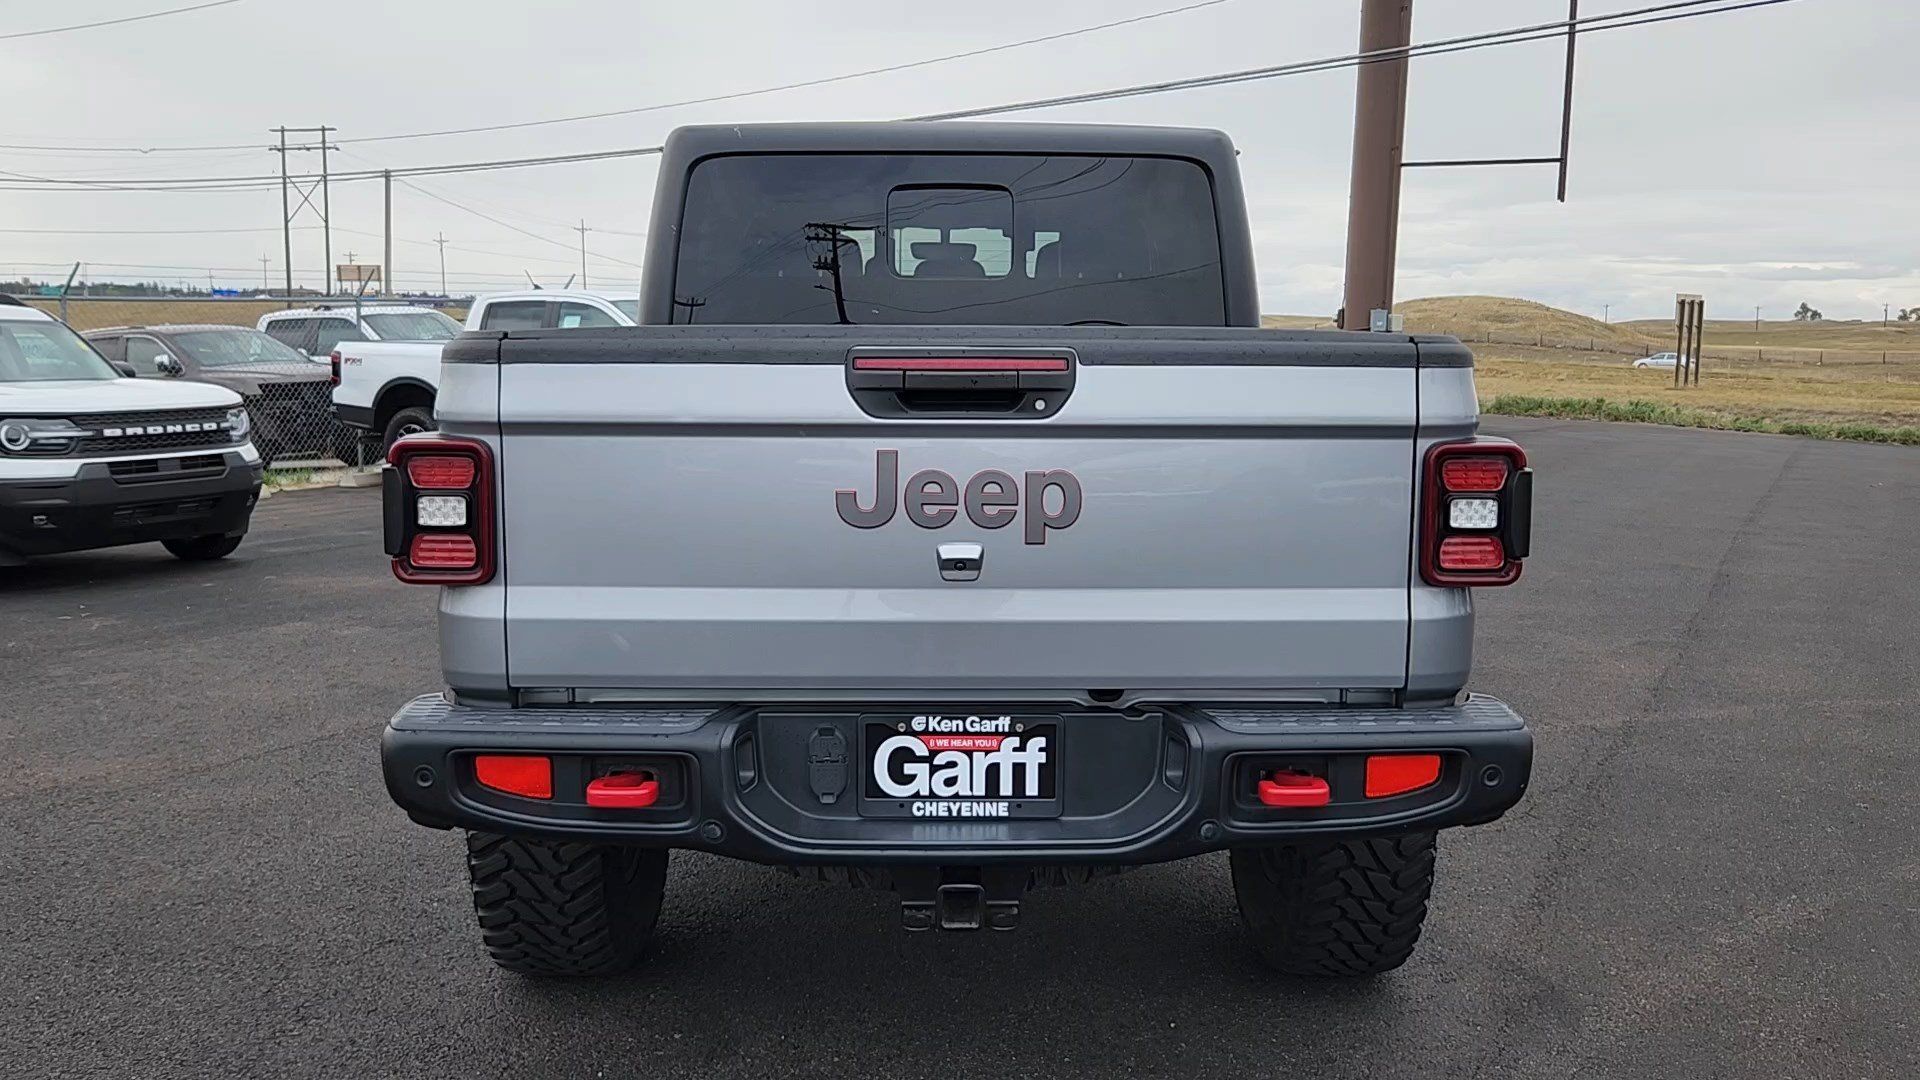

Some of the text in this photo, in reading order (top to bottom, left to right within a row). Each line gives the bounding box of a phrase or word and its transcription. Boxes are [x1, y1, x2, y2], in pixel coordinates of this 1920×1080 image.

[103, 422, 218, 437] BRONCO
[835, 449, 1083, 545] Jeep
[928, 716, 963, 732] Ken
[965, 716, 1011, 732] Garff
[936, 739, 991, 747] WE HEAR YOU
[873, 735, 1046, 797] Garff
[912, 801, 1009, 817] CHEYENNE
